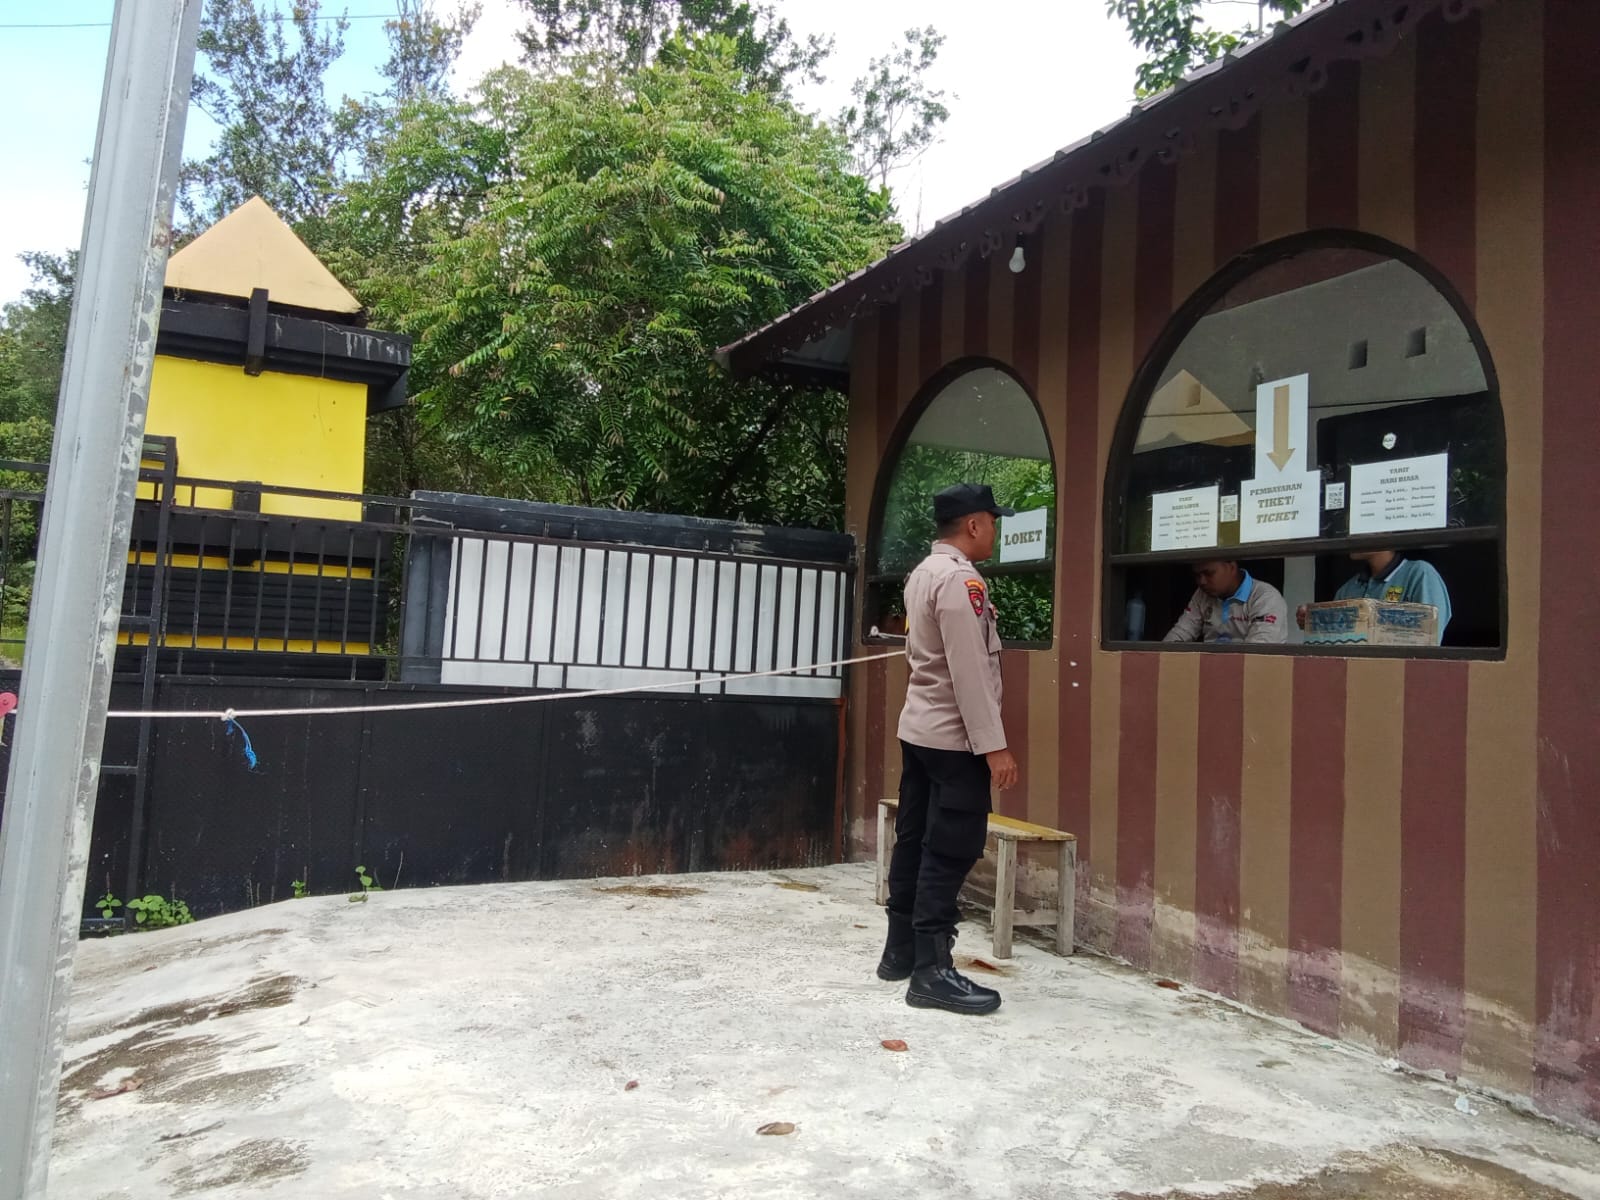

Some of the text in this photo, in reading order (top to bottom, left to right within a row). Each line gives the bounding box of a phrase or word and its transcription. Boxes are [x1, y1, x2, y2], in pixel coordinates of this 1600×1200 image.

[1249, 483, 1302, 496] PEMBAYARAN
[1258, 495, 1295, 508] TIKET/
[1256, 510, 1299, 524] TICKET
[1004, 530, 1042, 546] LOKET
